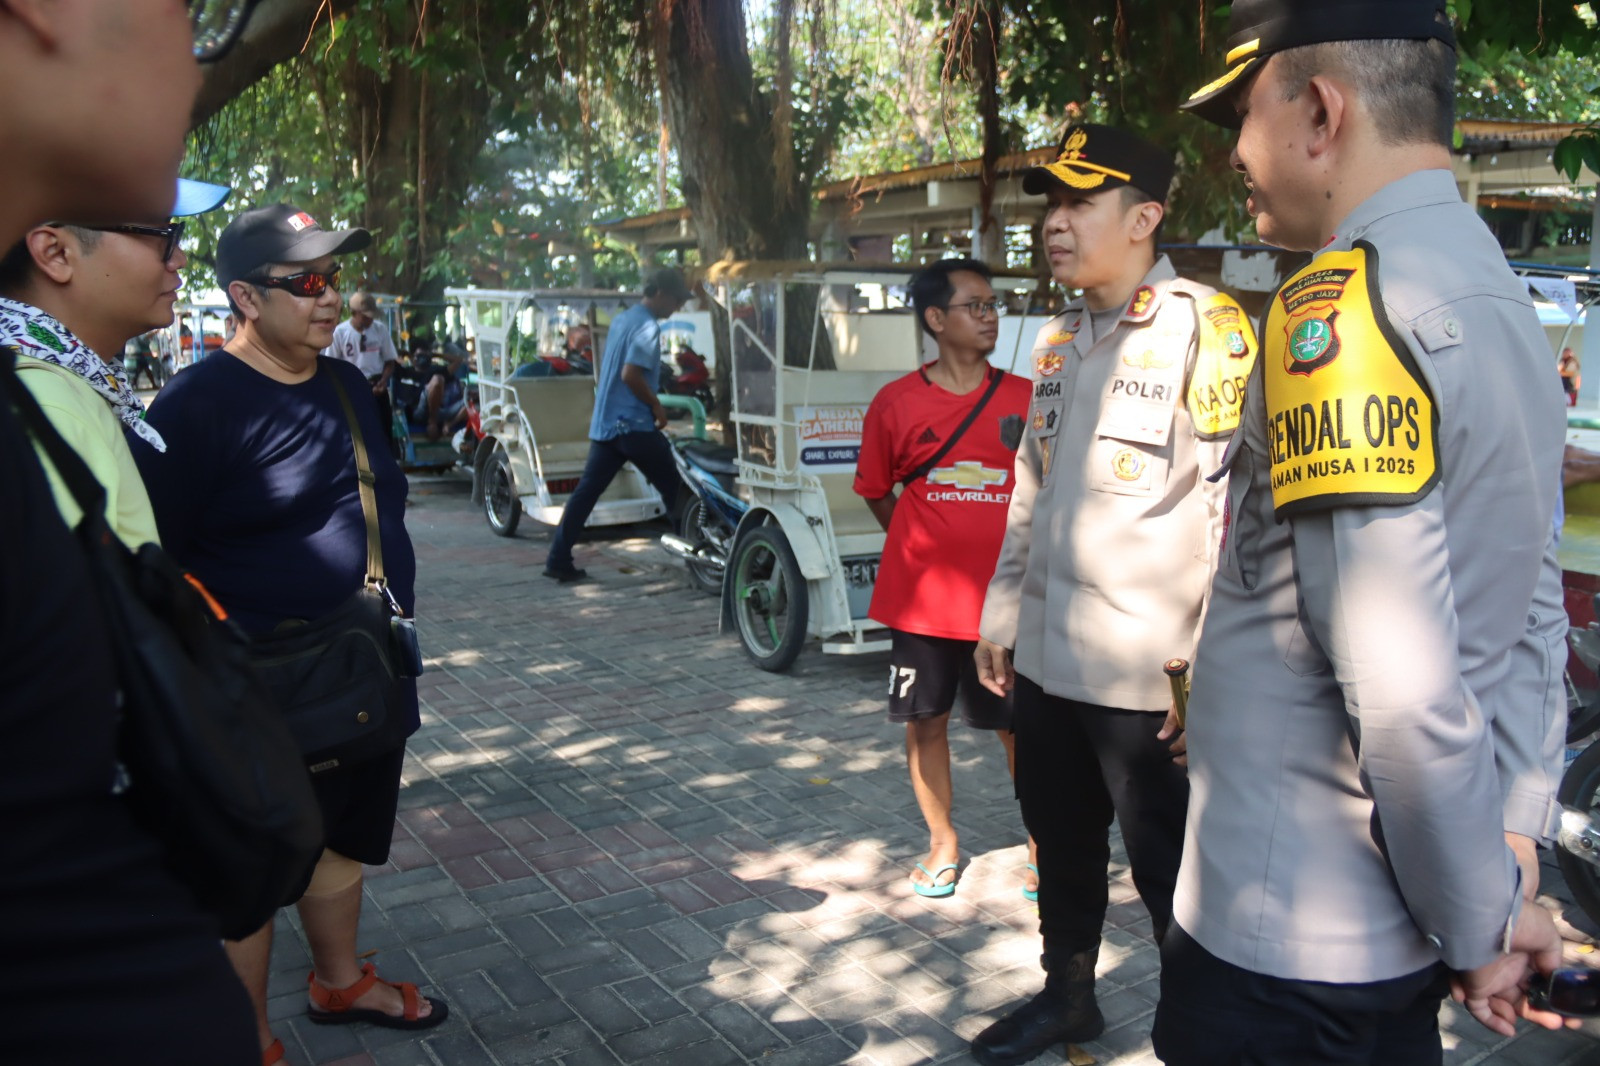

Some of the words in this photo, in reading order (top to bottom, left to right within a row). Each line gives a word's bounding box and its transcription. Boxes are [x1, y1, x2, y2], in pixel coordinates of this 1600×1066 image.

[1316, 290, 1338, 298] JAYA
[1034, 381, 1062, 399] ARGA
[1112, 378, 1173, 401] POLRI
[1363, 394, 1420, 451] OPS
[1307, 457, 1356, 479] NUSA
[1376, 456, 1415, 475] 2025
[926, 491, 1011, 504] CHEVROLET
